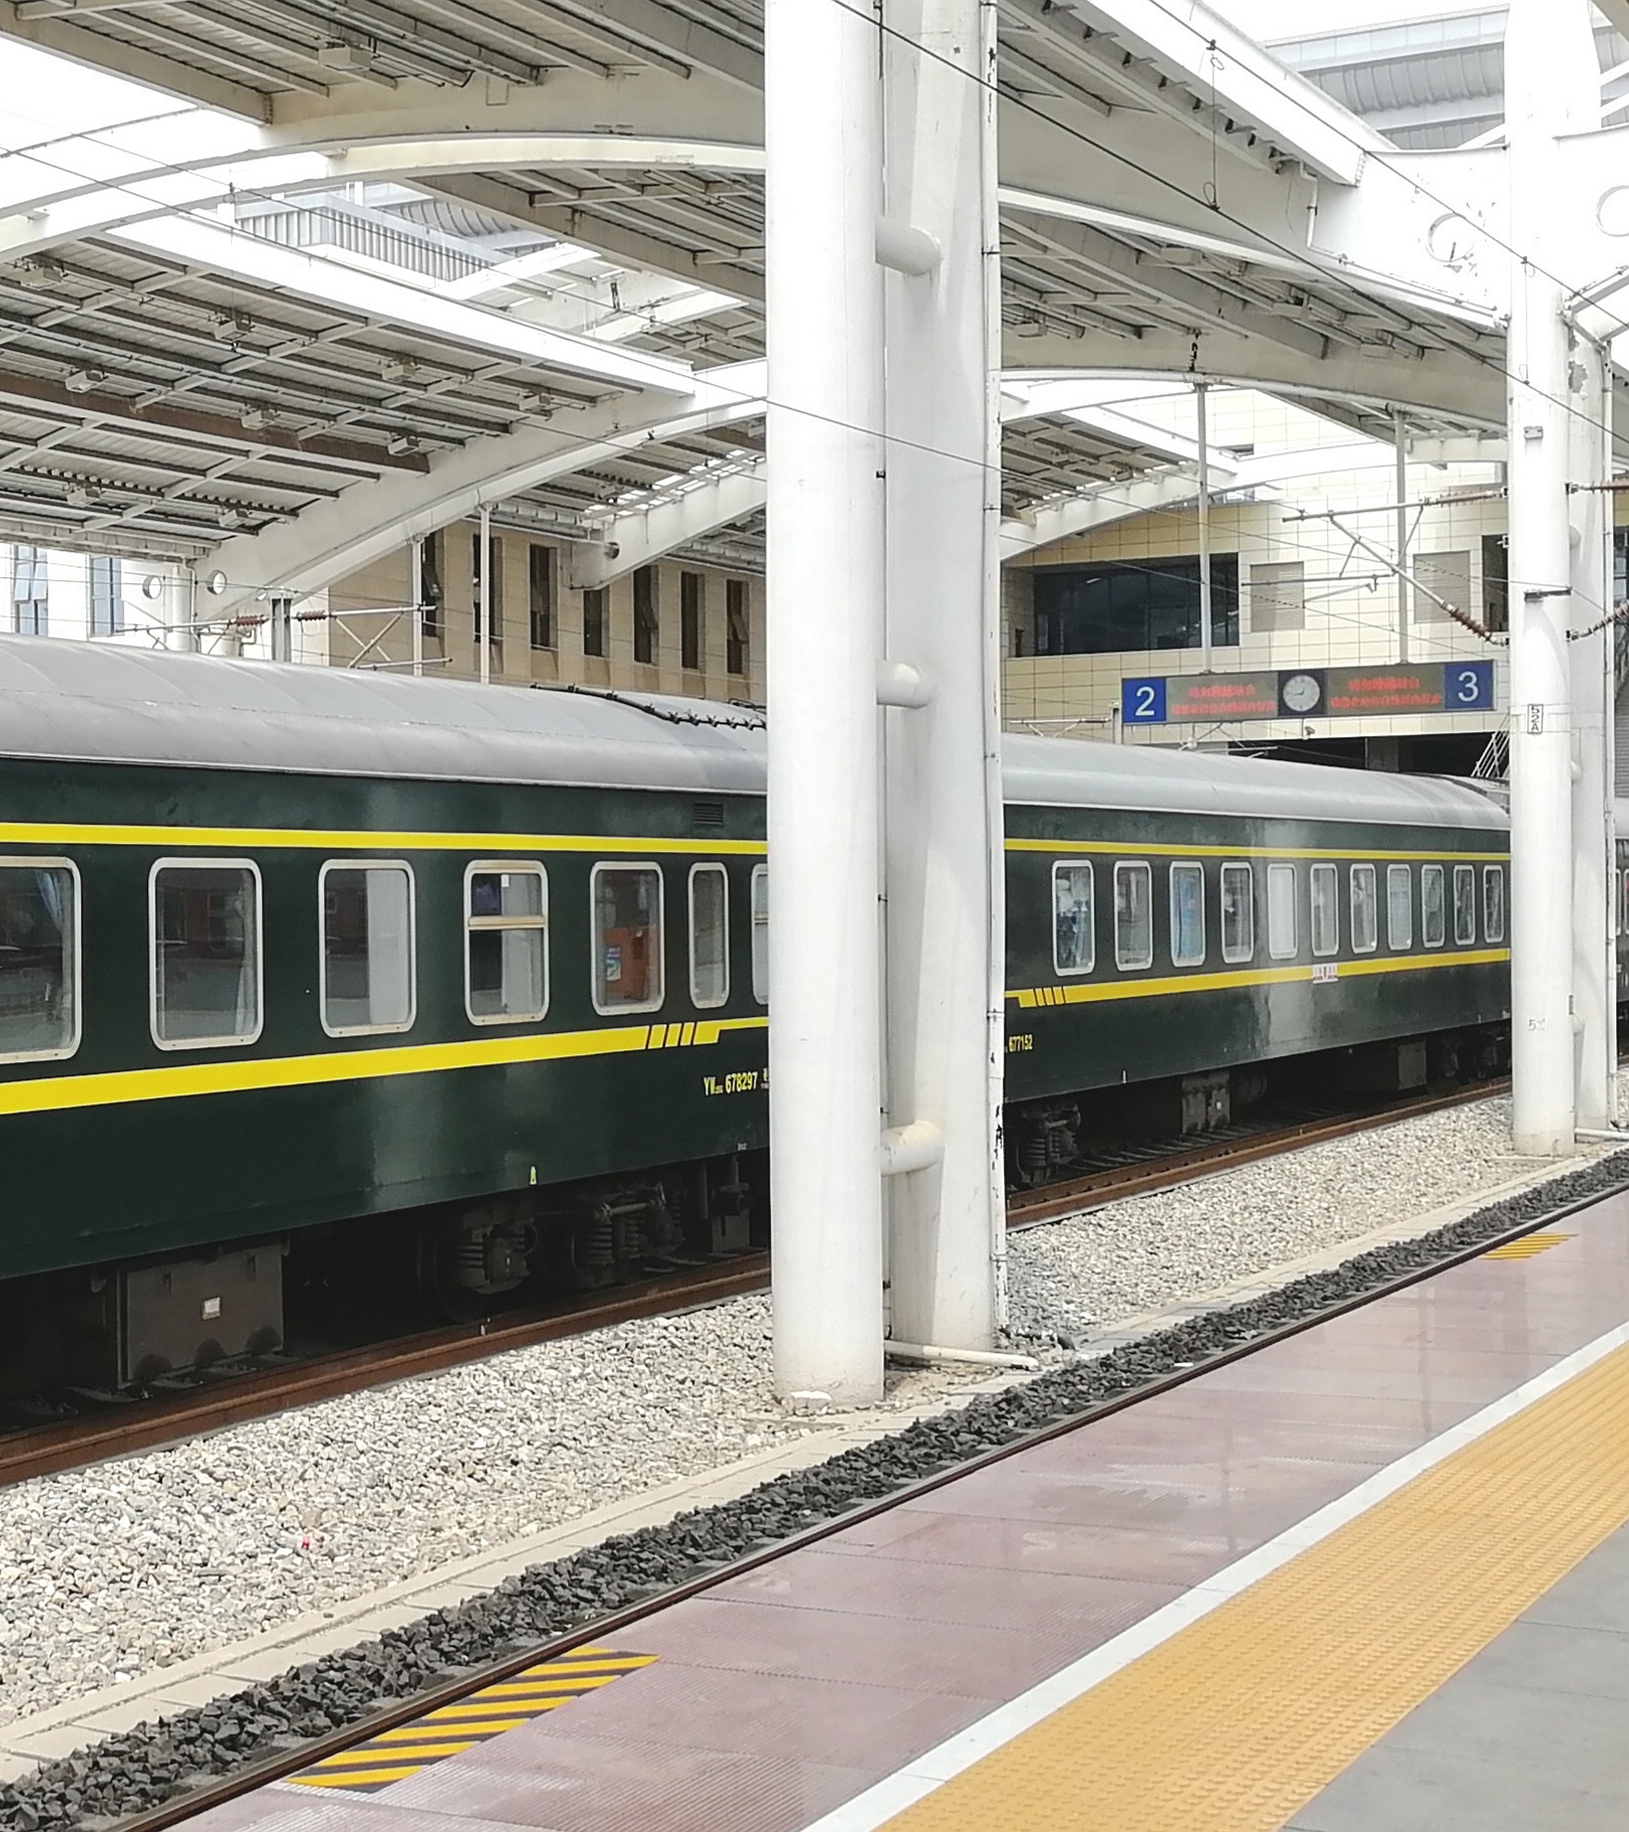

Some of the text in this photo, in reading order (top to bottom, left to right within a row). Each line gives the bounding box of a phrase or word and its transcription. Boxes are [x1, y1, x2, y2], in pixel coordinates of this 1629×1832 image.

[1458, 671, 1479, 702] 3
[1135, 686, 1155, 716] 2
[1531, 705, 1540, 731] 52A
[725, 1071, 758, 1094] 678297
